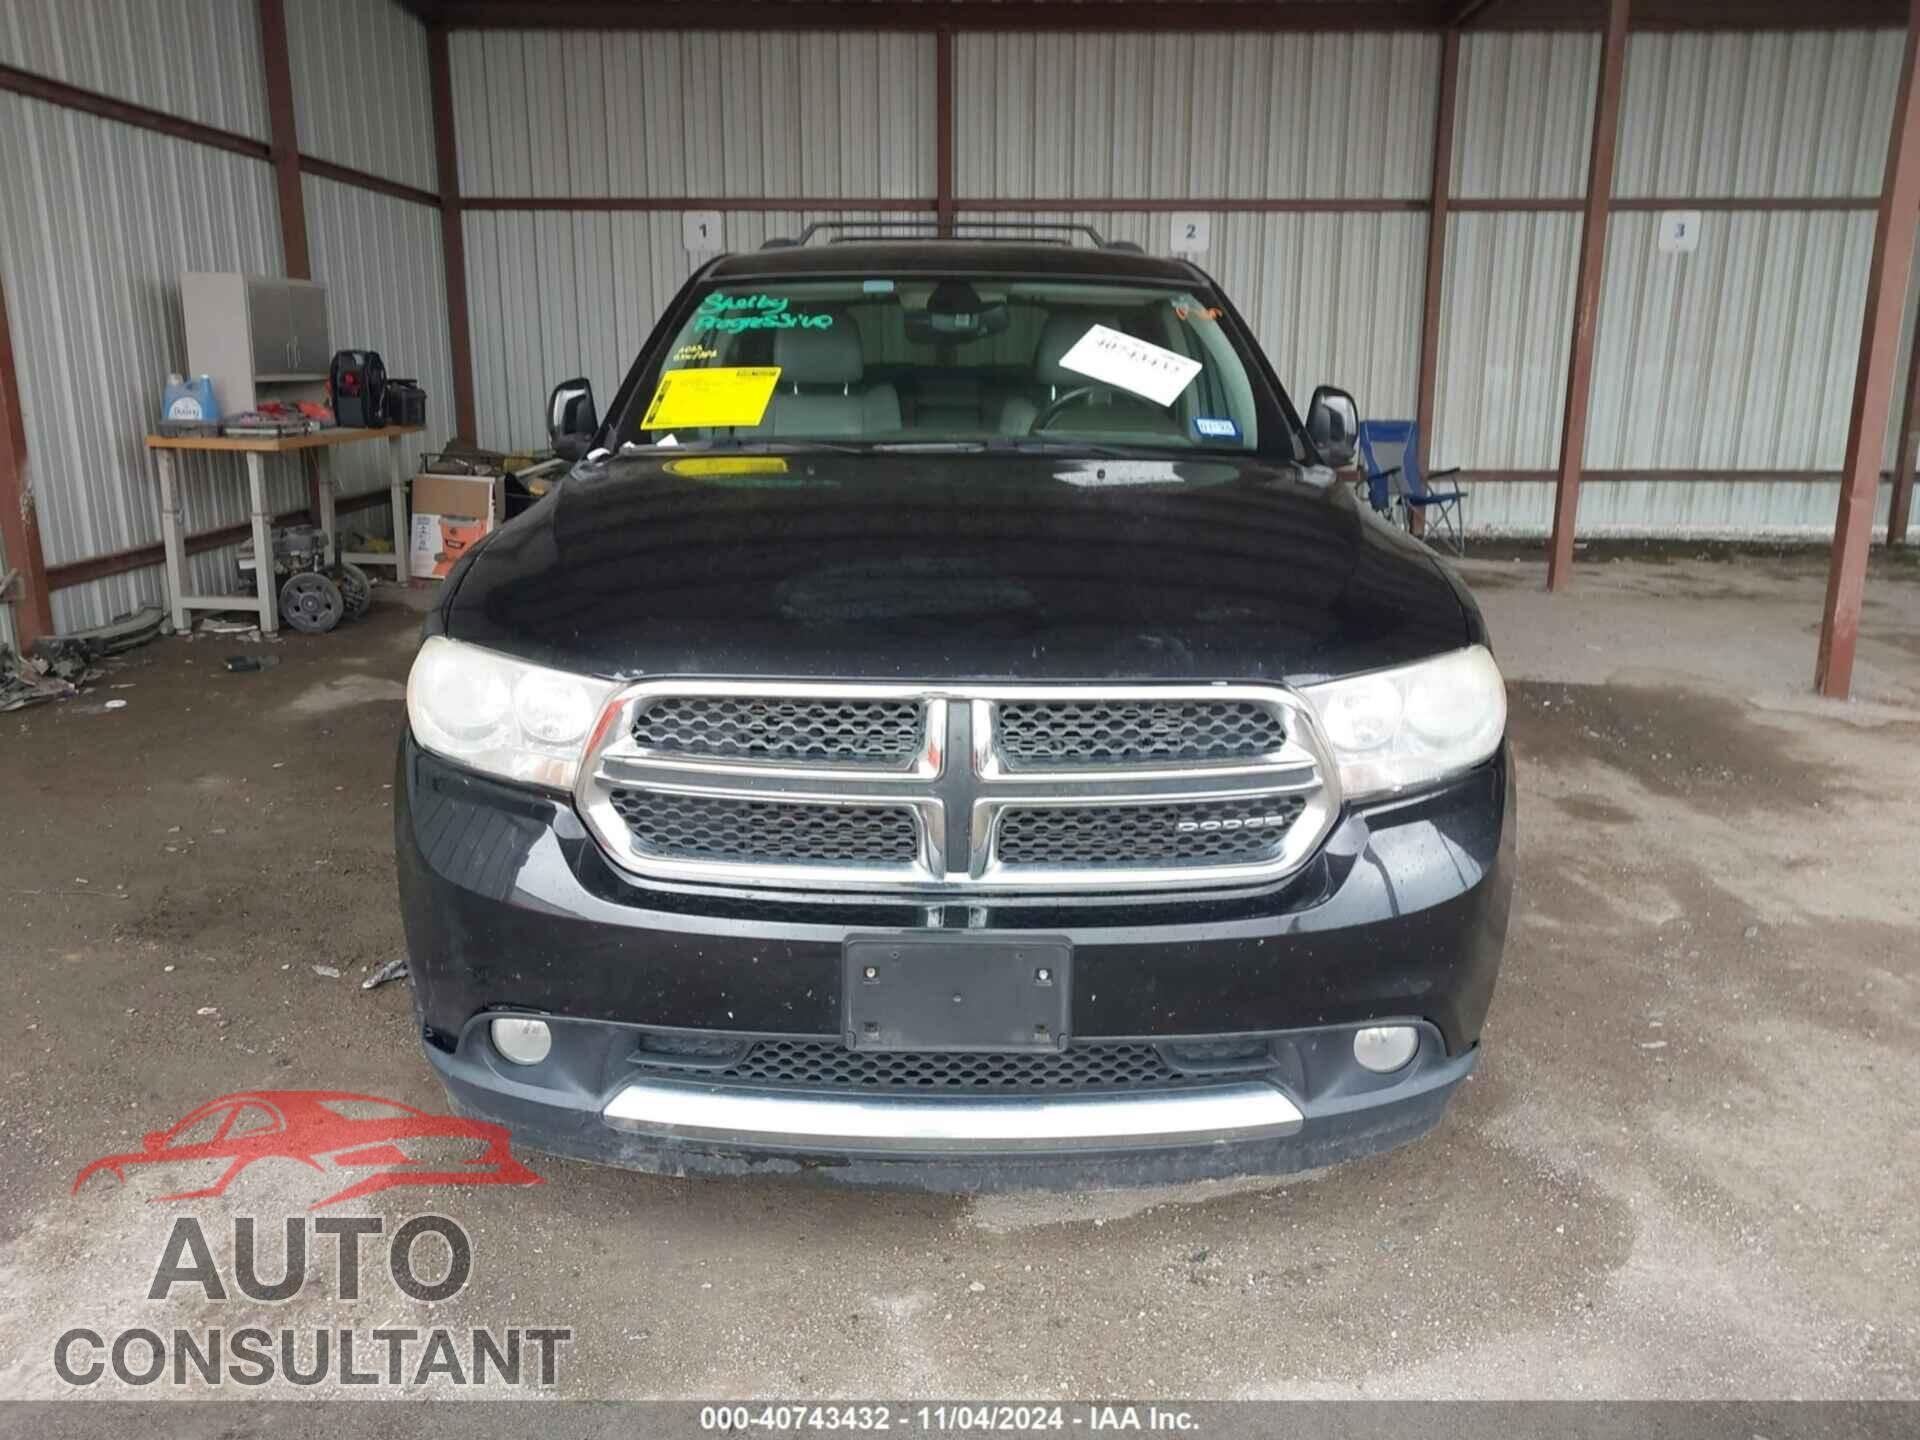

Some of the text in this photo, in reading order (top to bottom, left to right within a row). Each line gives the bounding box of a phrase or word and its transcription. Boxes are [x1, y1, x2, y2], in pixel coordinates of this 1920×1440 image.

[698, 223, 708, 239] 1
[1184, 223, 1197, 240] 2
[1674, 222, 1686, 239] 3
[1178, 815, 1284, 833] DODGE
